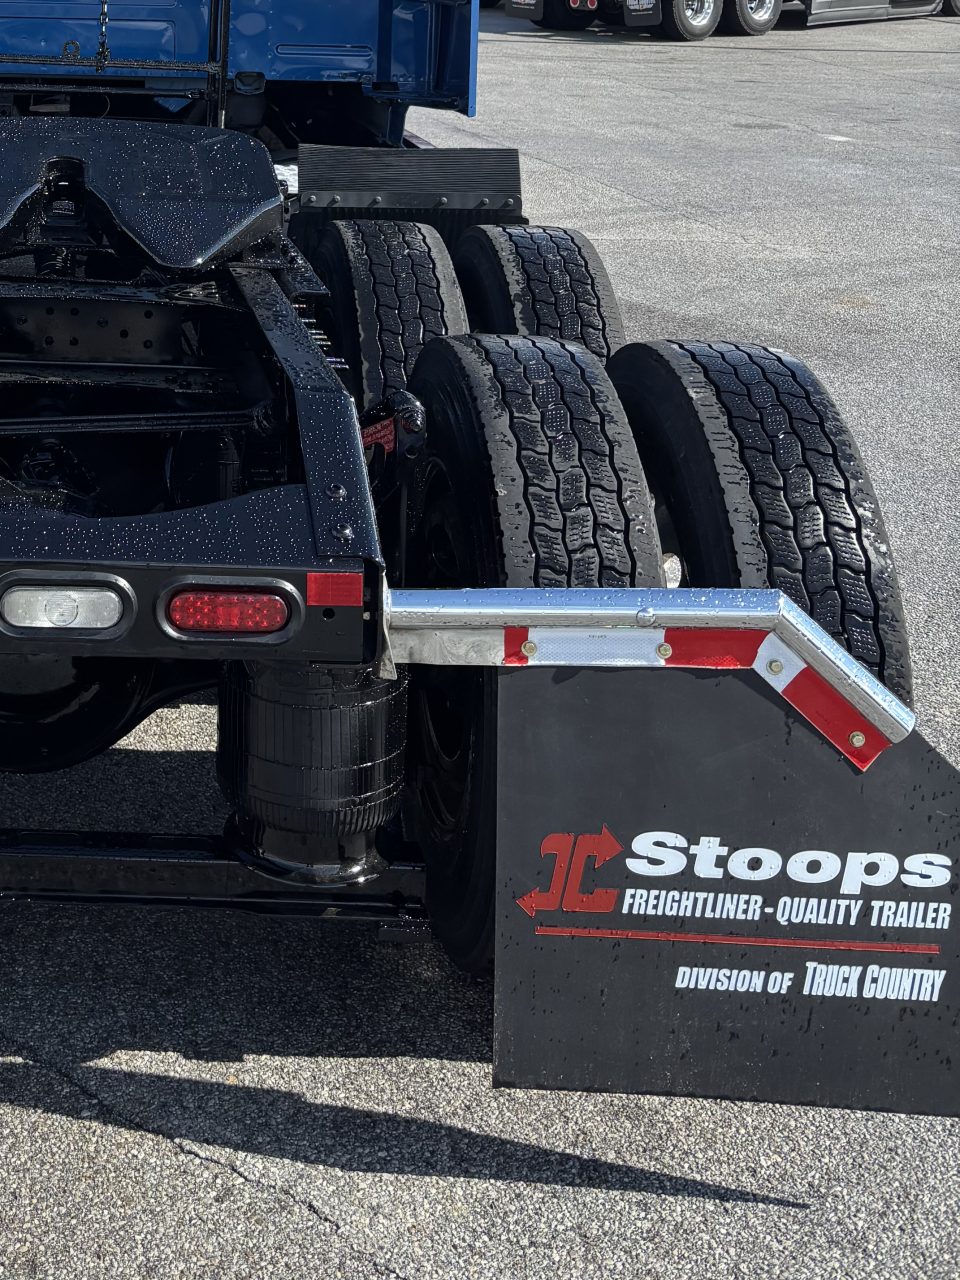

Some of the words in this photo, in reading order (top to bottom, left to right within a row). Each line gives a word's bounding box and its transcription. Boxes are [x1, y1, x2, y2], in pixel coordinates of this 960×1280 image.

[624, 830, 953, 895] Stoops
[869, 899, 952, 930] TRAILER
[674, 966, 766, 993] DIVISION
[766, 970, 795, 995] OF
[802, 961, 863, 998] TRUCK
[862, 964, 947, 1002] COUNTRY
